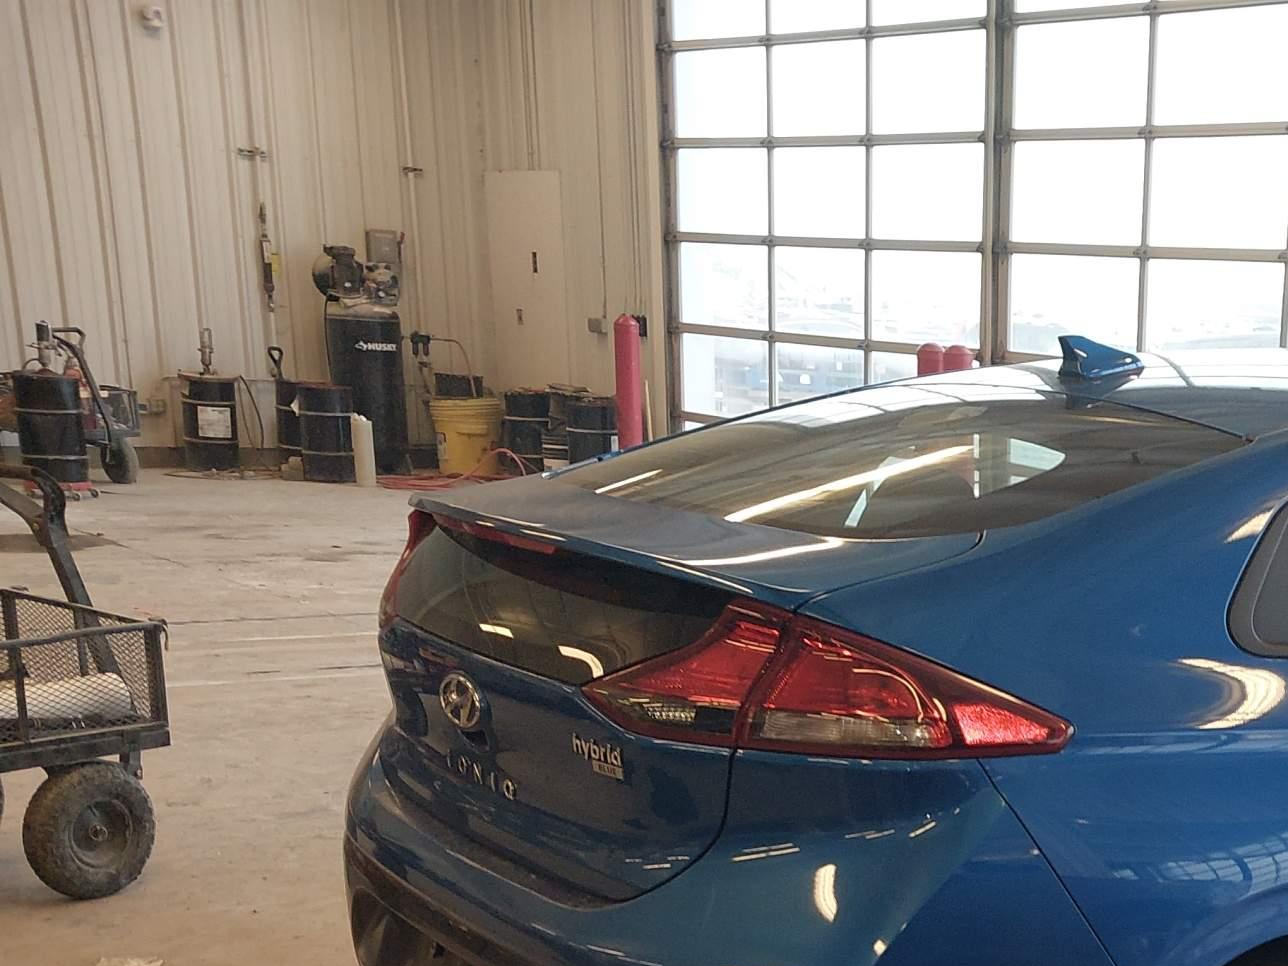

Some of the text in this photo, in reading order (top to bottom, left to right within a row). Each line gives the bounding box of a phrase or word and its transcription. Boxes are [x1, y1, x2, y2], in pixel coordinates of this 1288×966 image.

[367, 342, 398, 351] HUSKY
[571, 732, 622, 767] hybrid
[446, 751, 518, 800] IONIQ
